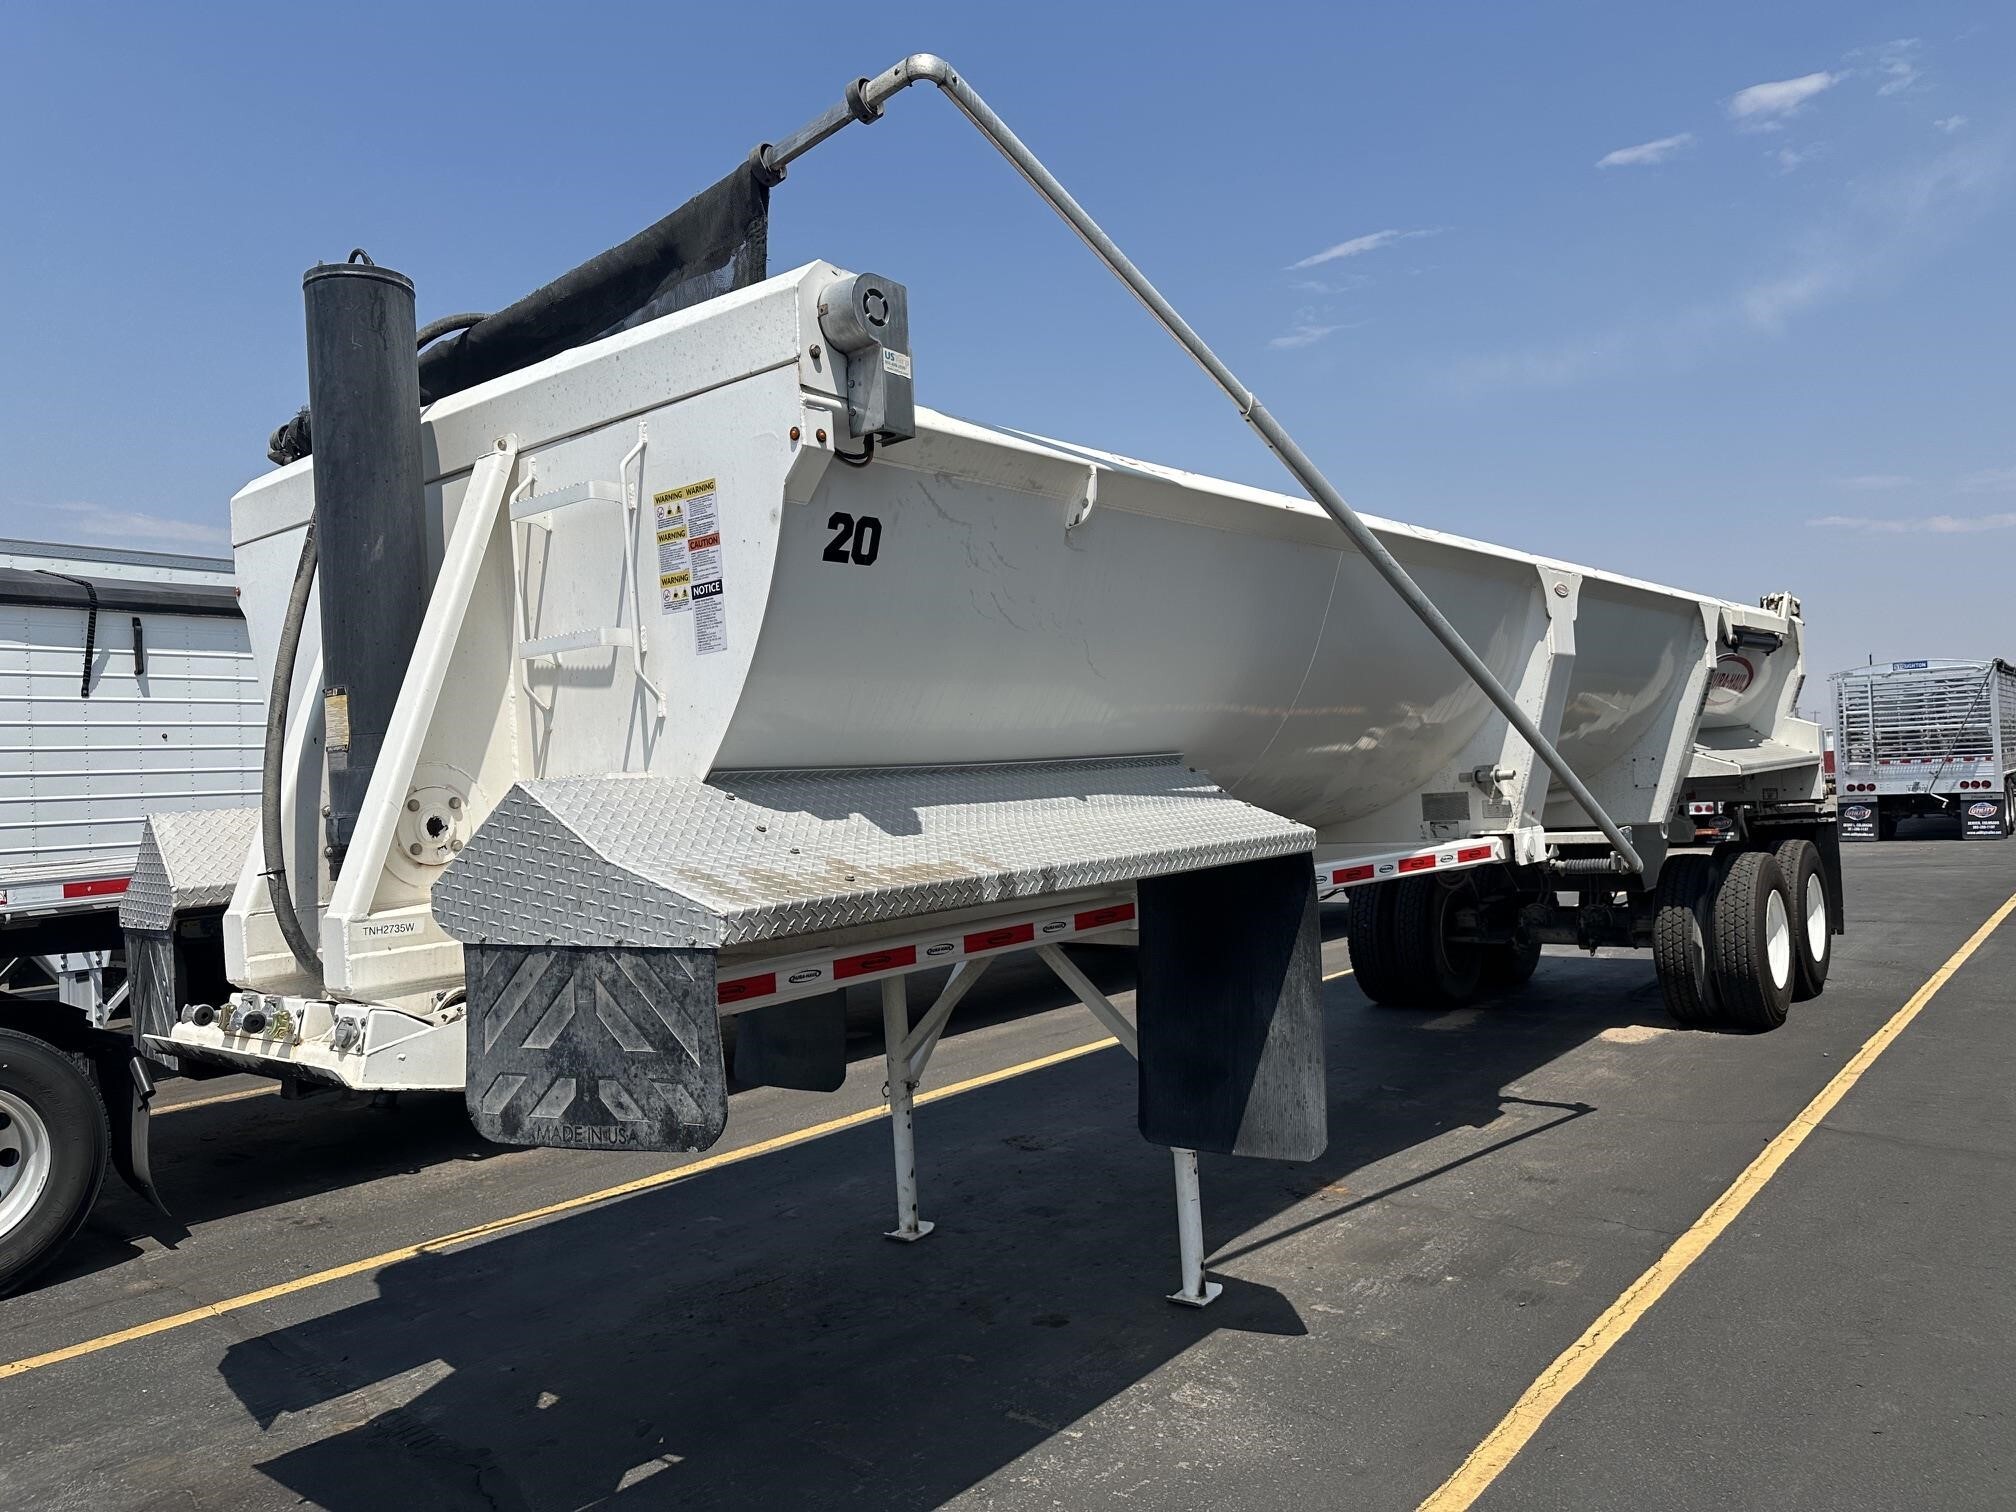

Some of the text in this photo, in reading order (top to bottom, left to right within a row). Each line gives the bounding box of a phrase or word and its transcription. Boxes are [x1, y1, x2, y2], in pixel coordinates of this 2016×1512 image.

[685, 481, 714, 496] WARNING
[655, 491, 683, 504] WARNING
[658, 529, 686, 542] WARNING
[822, 511, 882, 566] 20
[690, 536, 718, 550] CAUTION
[661, 573, 689, 586] WARNING
[693, 582, 721, 596] NOTICE
[362, 923, 415, 936] TNH2735W
[536, 1125, 640, 1145] MADE IN USA
